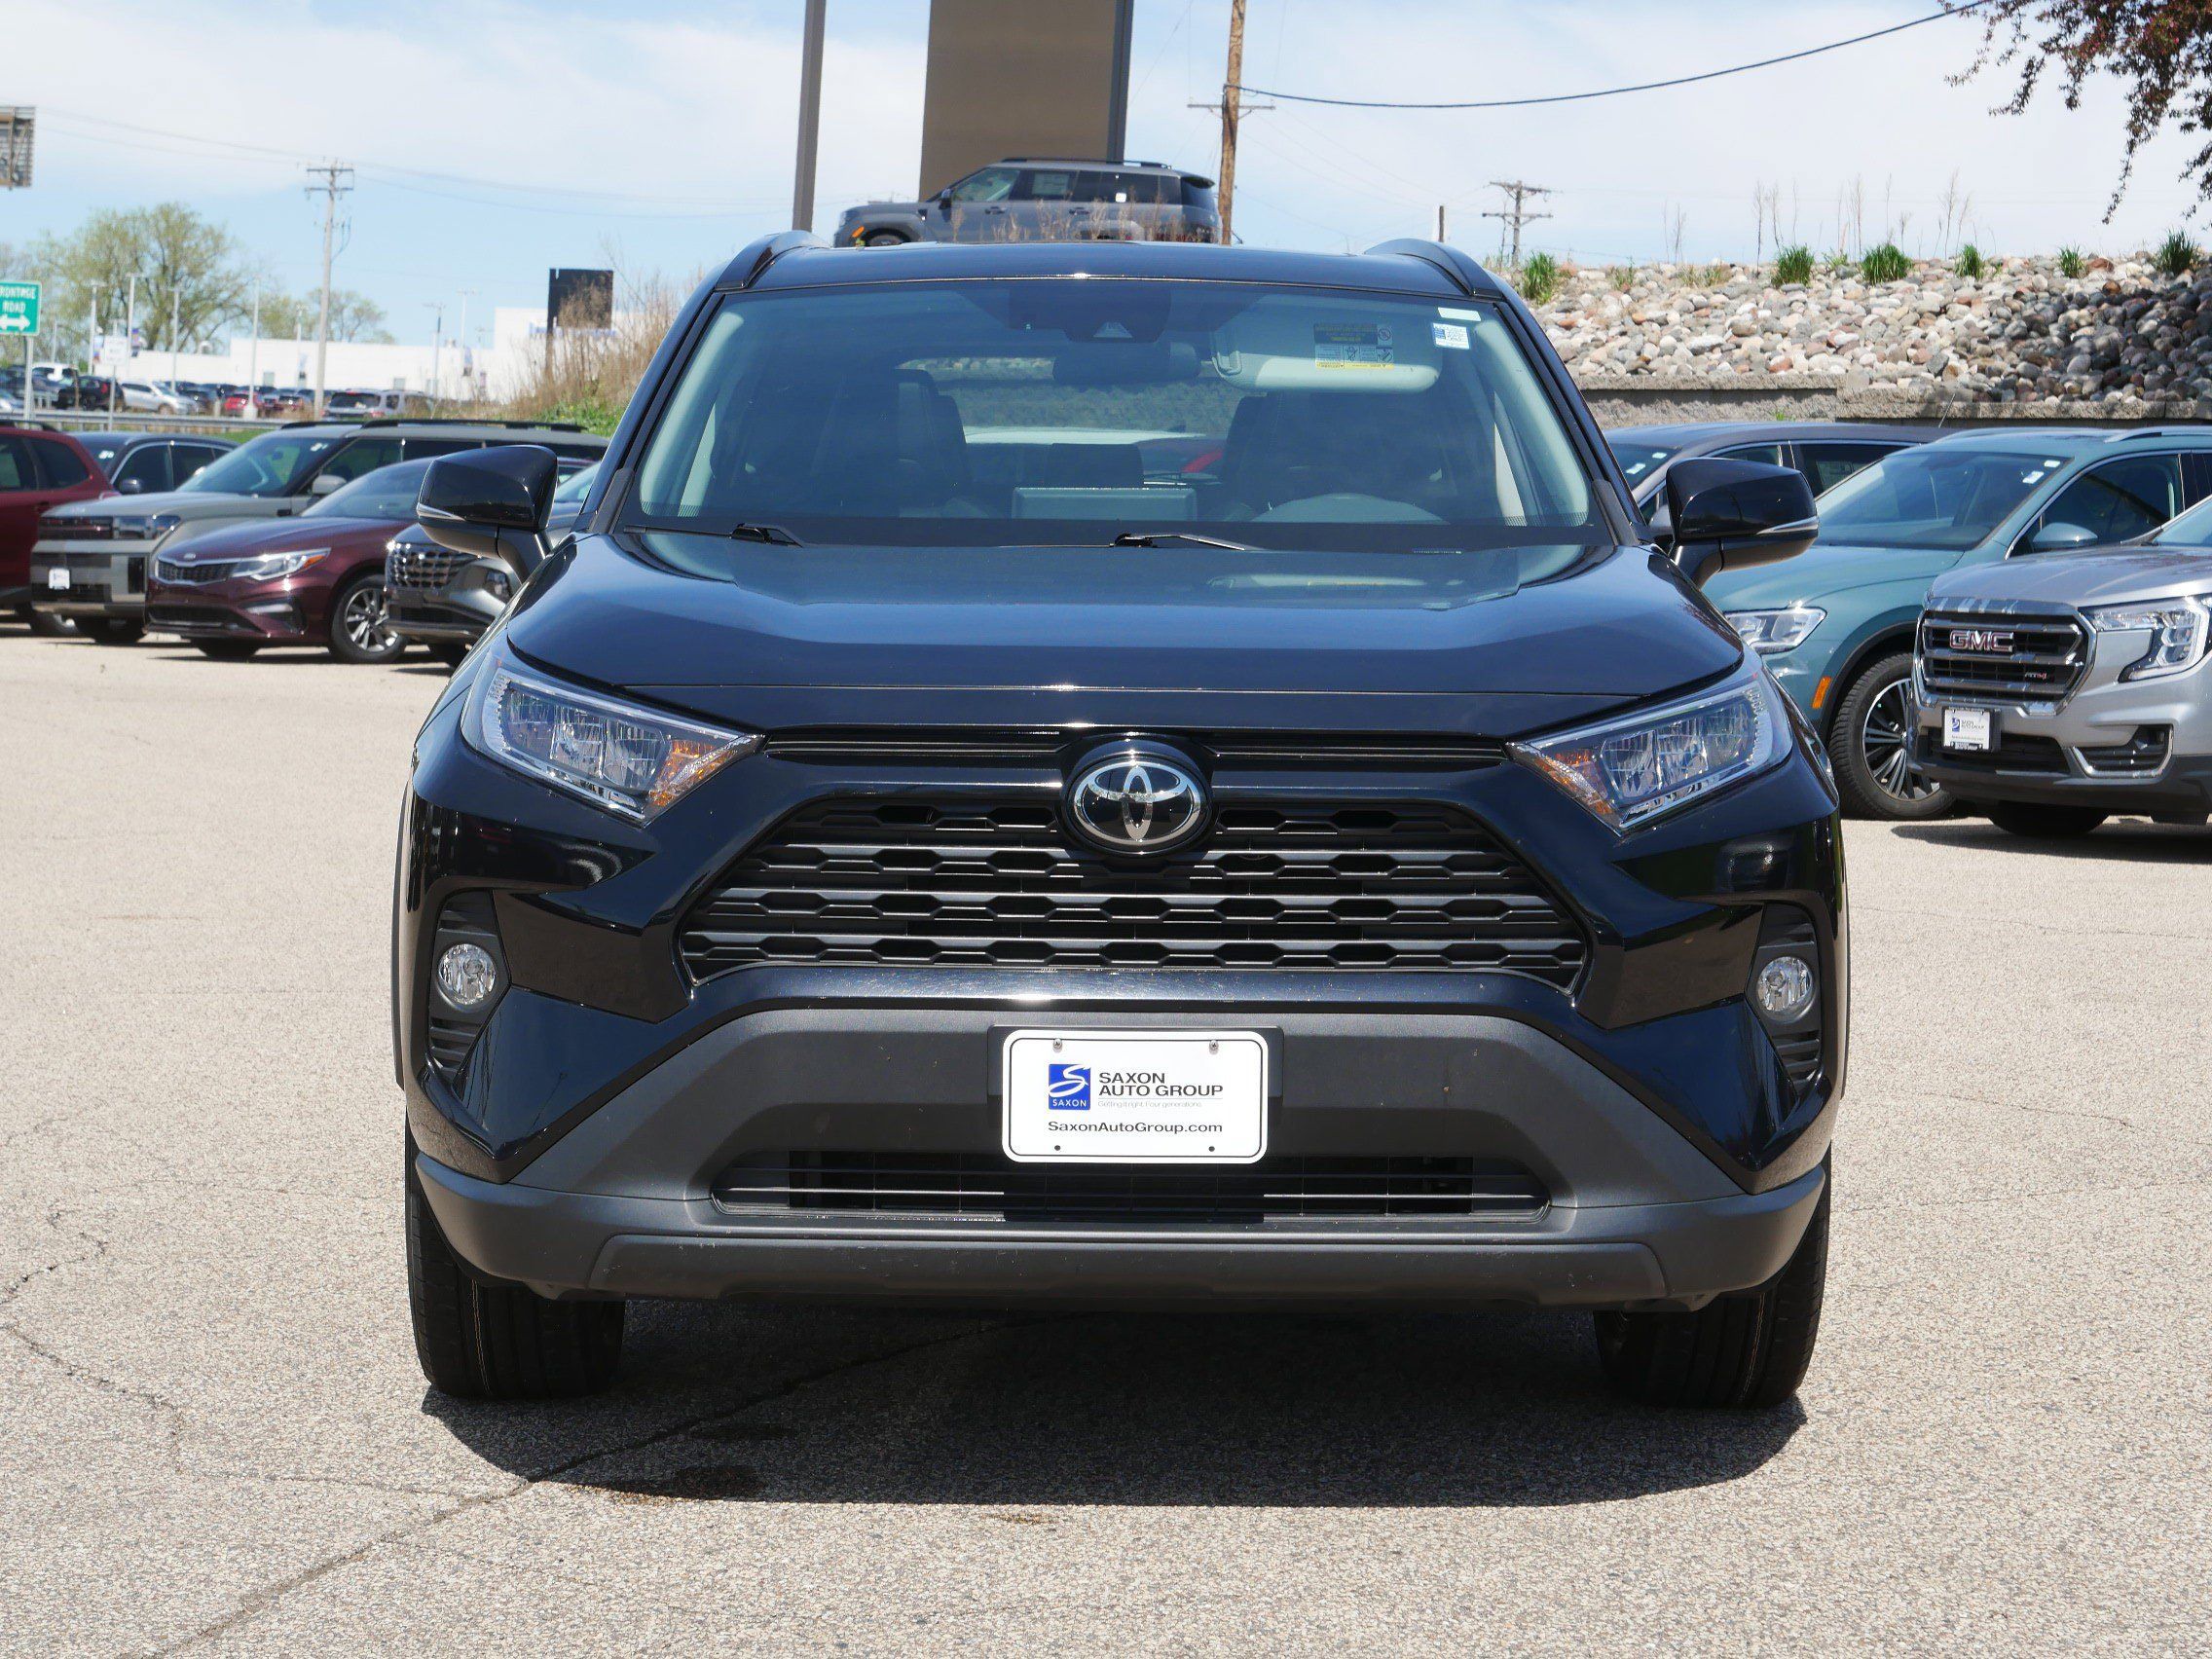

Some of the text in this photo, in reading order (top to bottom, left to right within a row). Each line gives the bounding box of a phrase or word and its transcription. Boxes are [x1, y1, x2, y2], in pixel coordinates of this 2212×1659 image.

[0, 285, 36, 299] RONTAGE
[2, 300, 26, 313] ROAD
[1949, 629, 2014, 652] GMC
[1098, 1072, 1165, 1084] SAXON
[1098, 1085, 1224, 1096] AUTO GROUP
[1048, 1121, 1223, 1134] SaxonAutoGroup.com
